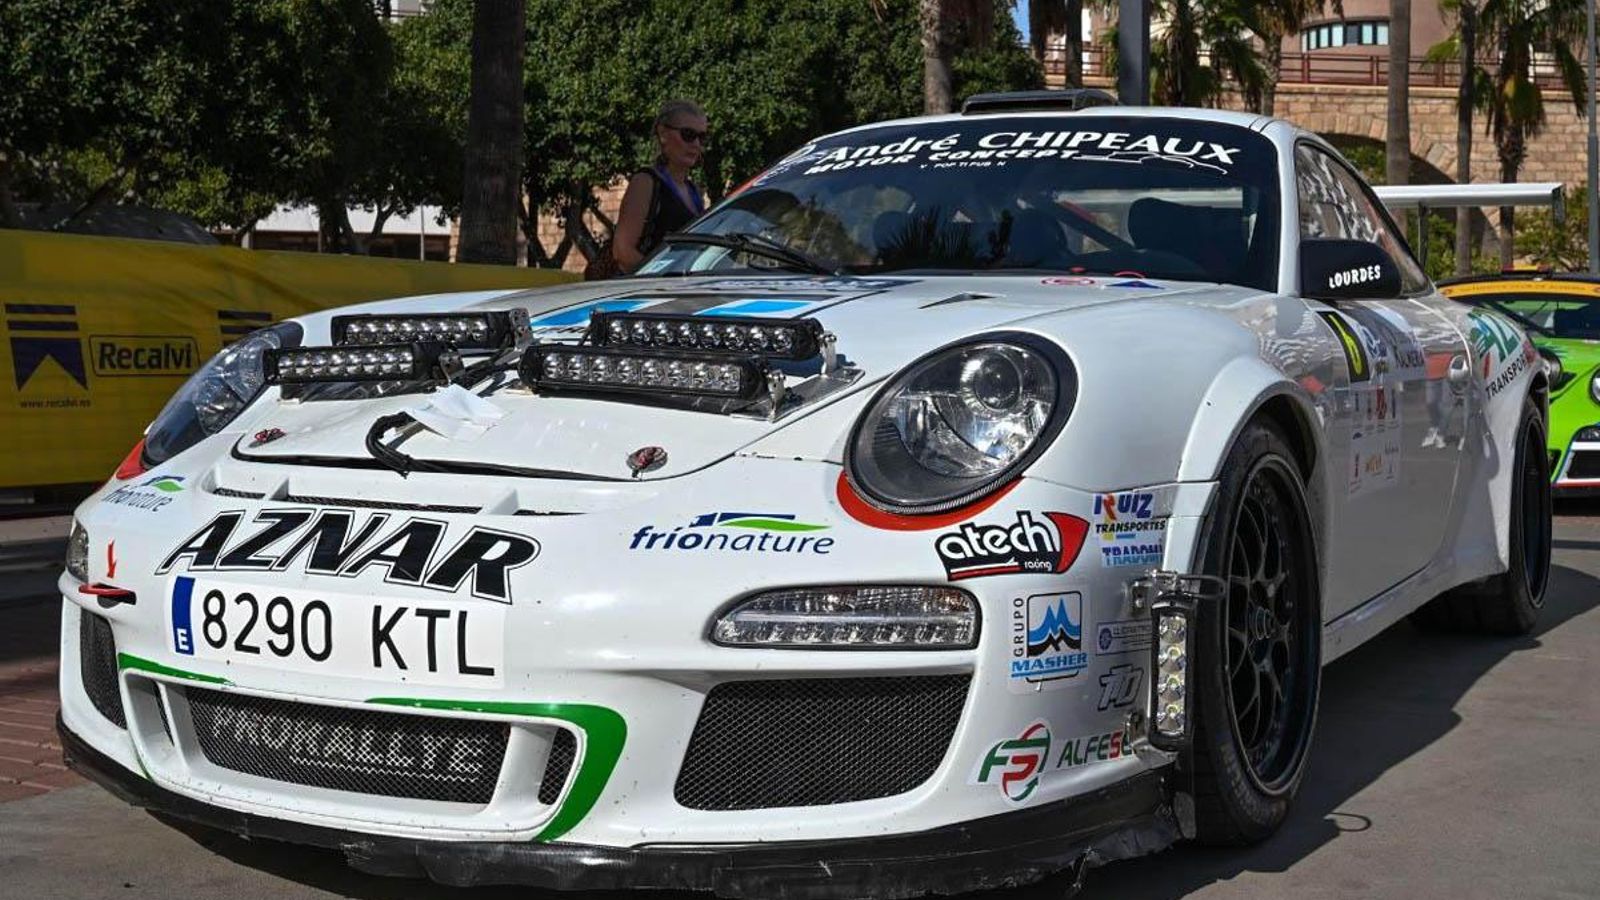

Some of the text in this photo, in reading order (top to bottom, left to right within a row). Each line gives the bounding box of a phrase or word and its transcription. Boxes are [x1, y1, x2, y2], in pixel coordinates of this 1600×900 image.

[803, 153, 917, 175] MOTOR
[928, 149, 1080, 162] CONCEPT
[815, 133, 961, 165] André
[978, 131, 1240, 166] CHIPEAUX
[1328, 264, 1381, 289] LOURDES
[98, 342, 193, 370] Recalvi
[936, 512, 1062, 563] atech
[1095, 520, 1167, 534] TRANSPORTES
[155, 508, 540, 605] AZNAR
[1024, 559, 1054, 575] racing
[176, 627, 190, 651] E
[202, 587, 496, 678] 8290 KTL
[1013, 596, 1026, 659] GRUPO
[1012, 653, 1088, 674] MASHER
